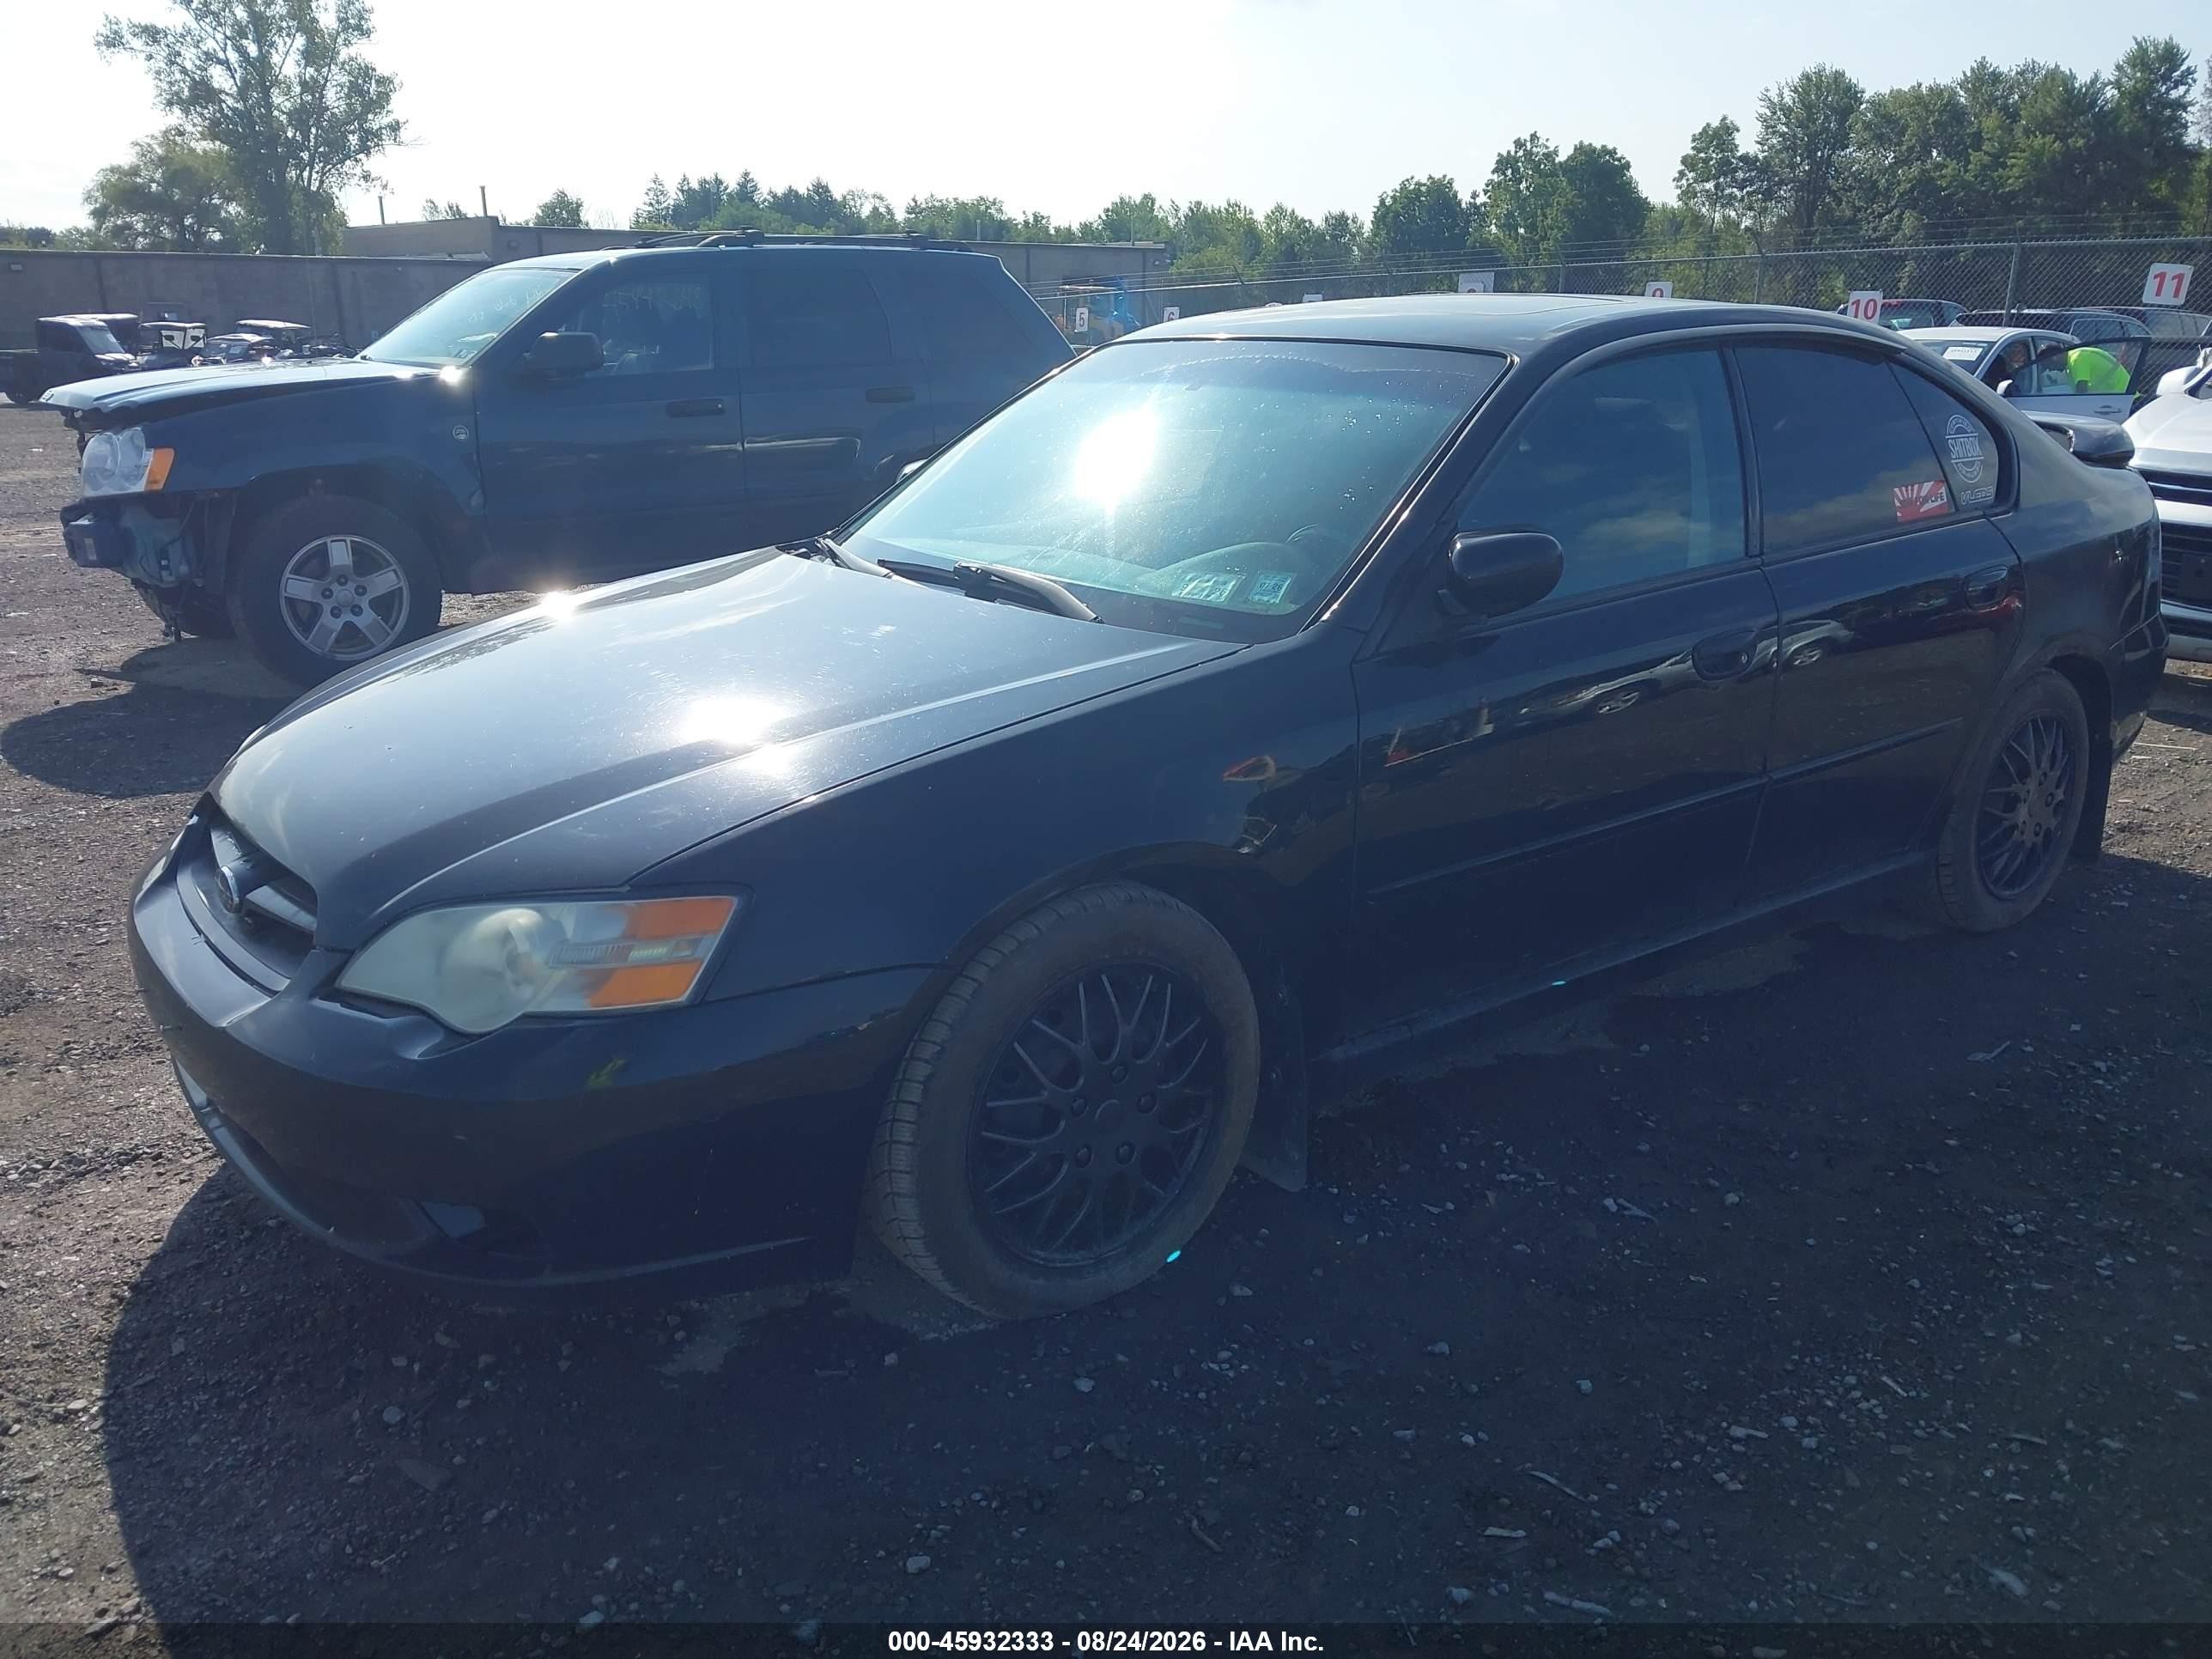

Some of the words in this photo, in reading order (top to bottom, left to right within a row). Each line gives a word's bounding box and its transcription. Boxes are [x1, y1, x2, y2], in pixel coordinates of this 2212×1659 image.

[2153, 271, 2185, 298] 11
[1079, 312, 1085, 327] 5
[1850, 298, 1878, 319] 10
[1948, 436, 1983, 459] SHITBOX
